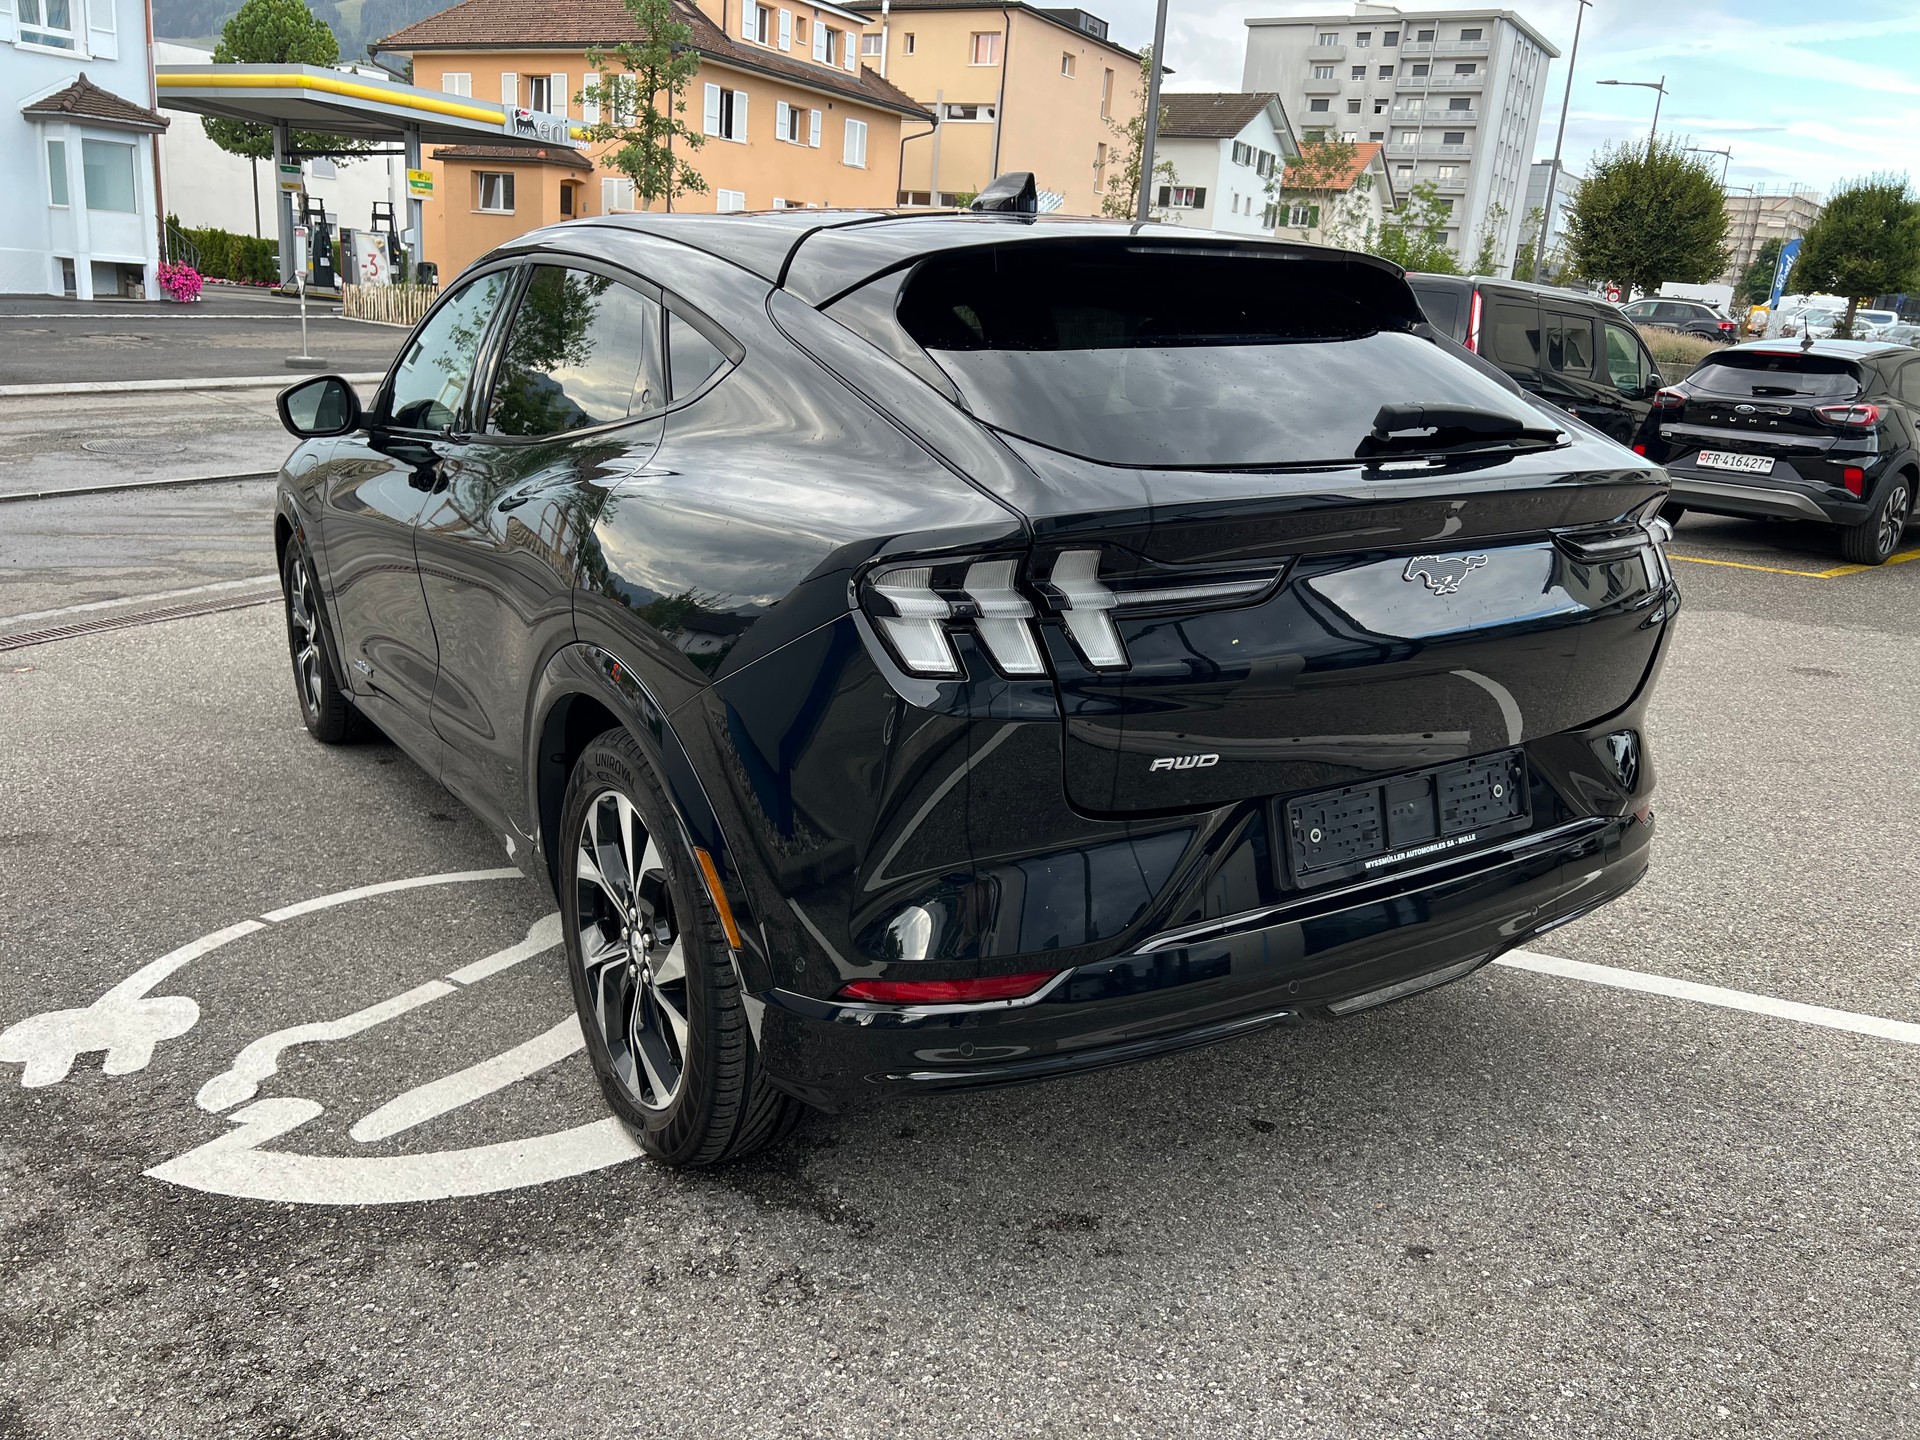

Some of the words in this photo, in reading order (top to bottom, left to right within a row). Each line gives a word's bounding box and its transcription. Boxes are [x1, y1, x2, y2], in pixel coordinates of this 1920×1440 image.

[538, 118, 568, 142] eni
[1711, 415, 1778, 426] PUMA
[595, 752, 635, 792] UNIROYAL
[1149, 753, 1220, 772] AWD
[1365, 851, 1406, 869] WYSSMÜLLER
[1406, 841, 1446, 859] AUTOMOBILES
[1446, 839, 1455, 848] SA
[1458, 833, 1476, 845] BULLE
